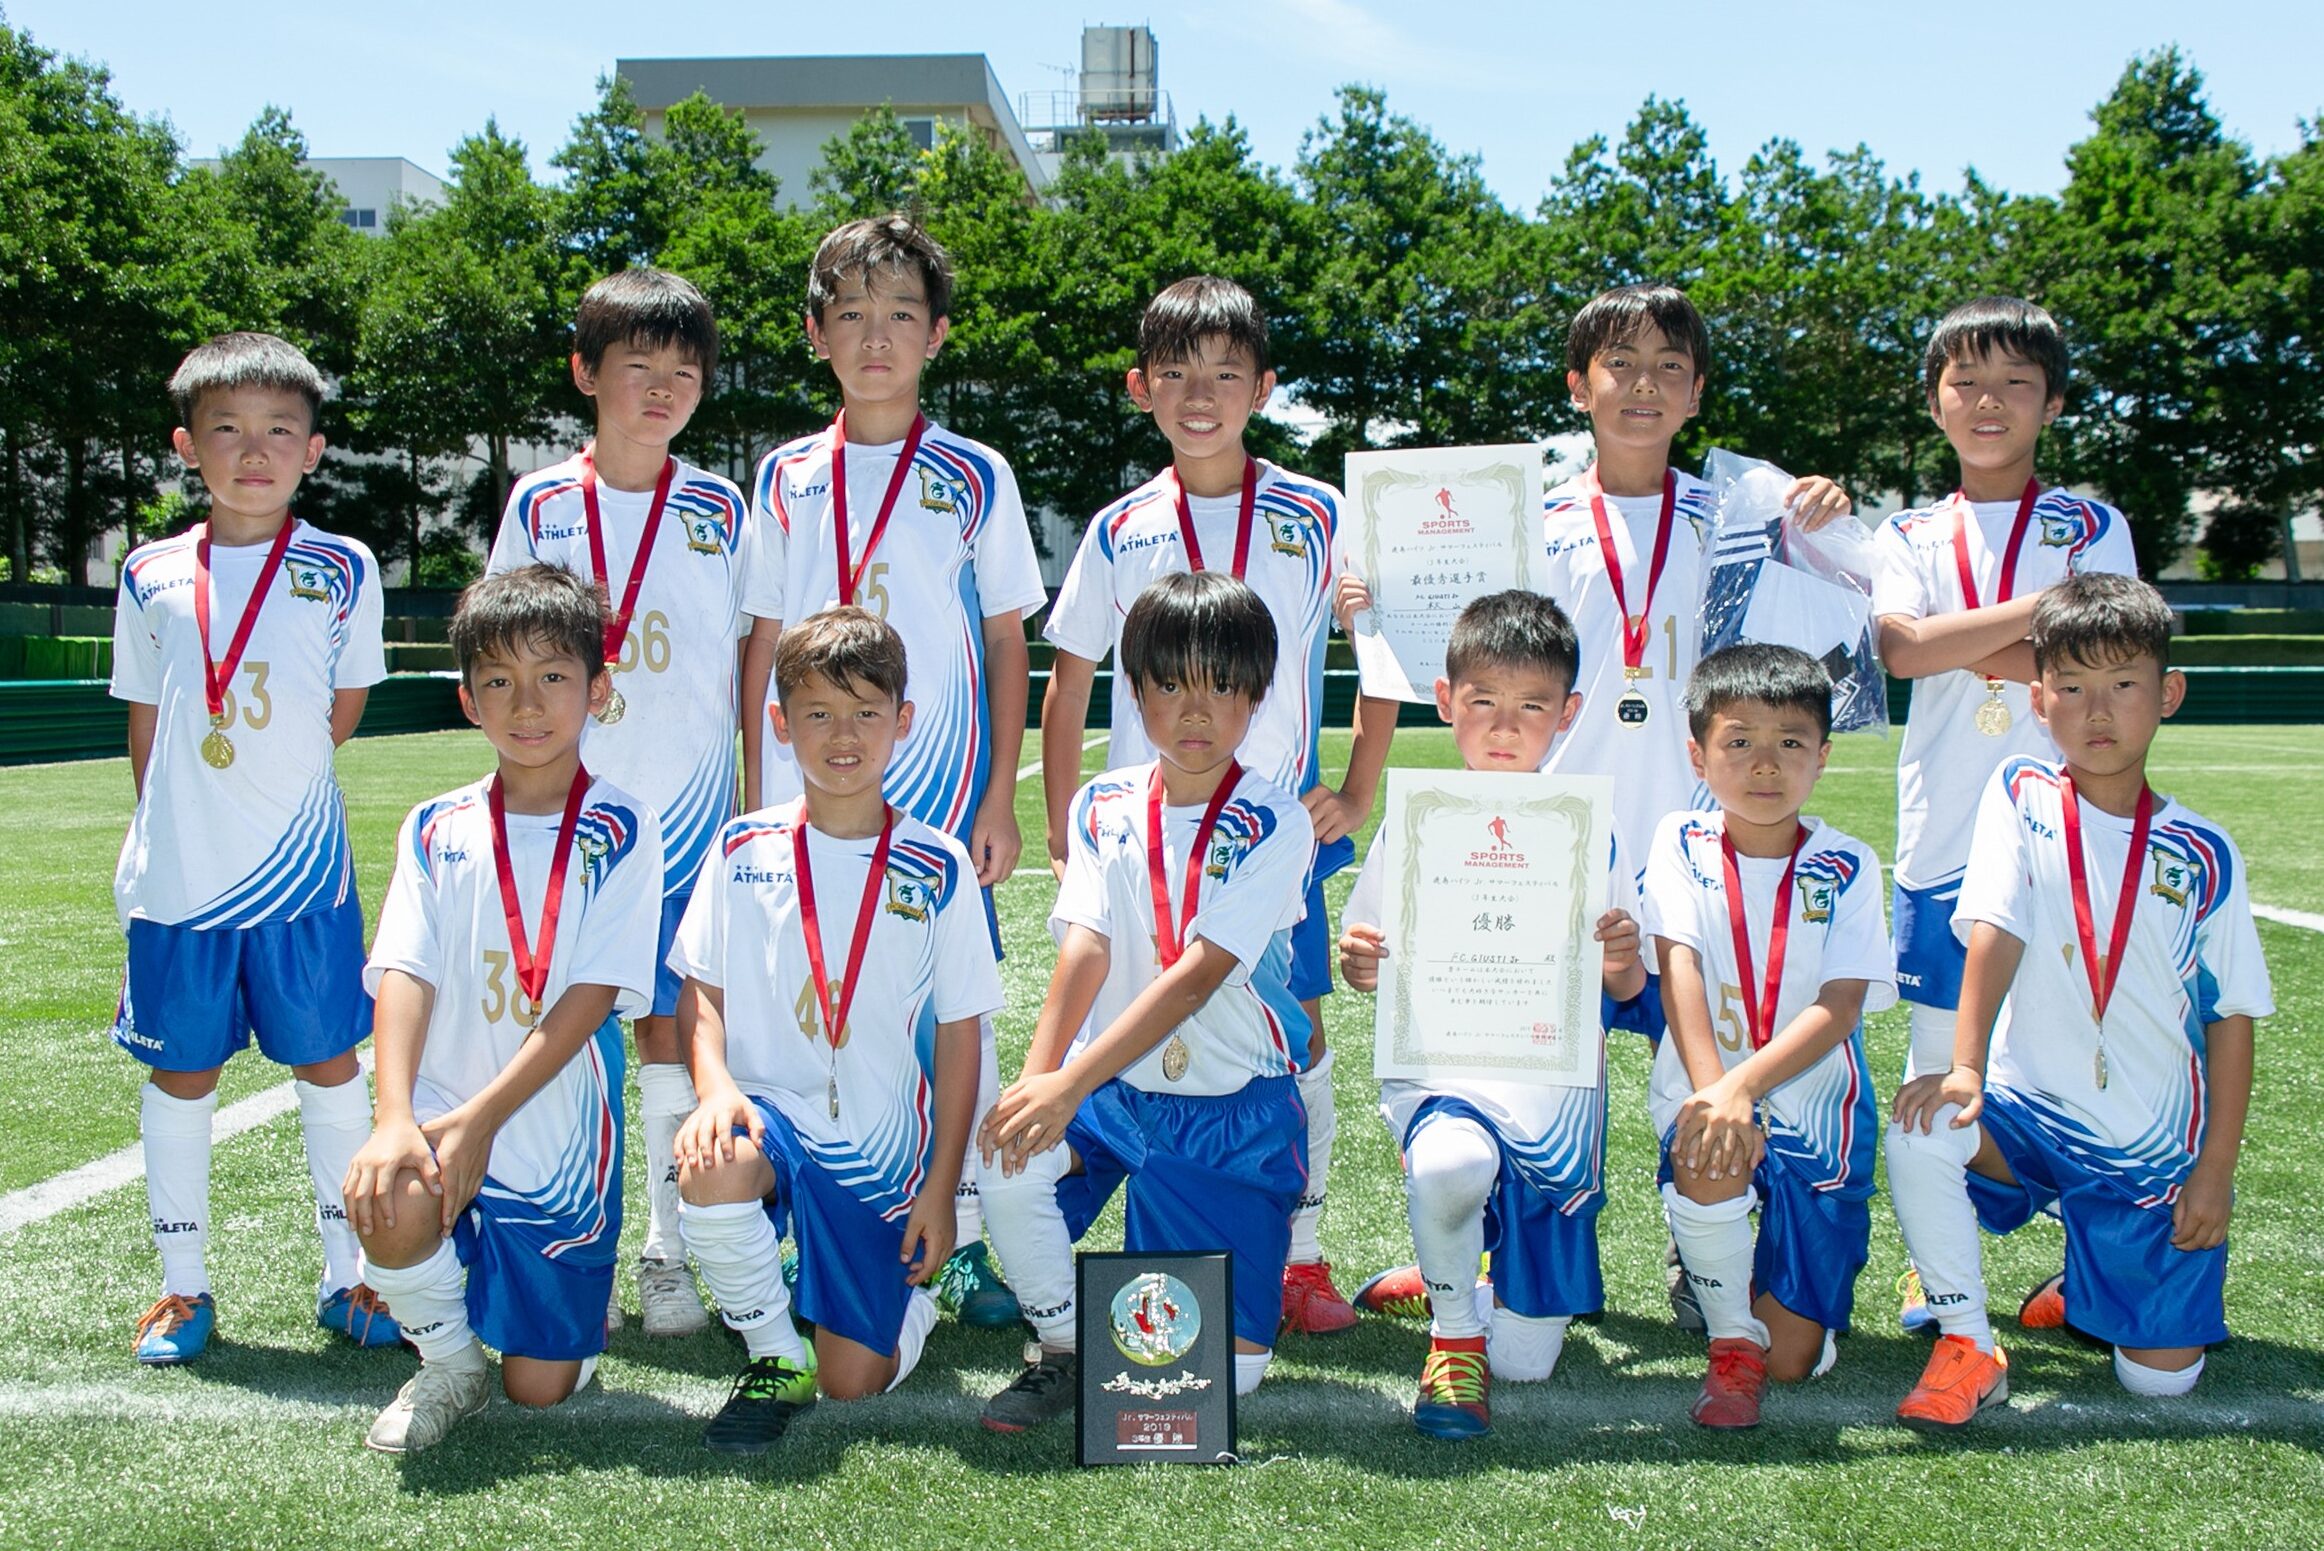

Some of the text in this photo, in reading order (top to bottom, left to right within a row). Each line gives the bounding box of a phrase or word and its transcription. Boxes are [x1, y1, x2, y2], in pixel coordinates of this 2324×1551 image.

[1422, 519, 1471, 529] SPORTS
[1417, 527, 1476, 536] MANAGEMENT
[1119, 532, 1178, 554] ATHLETA
[141, 577, 196, 603] ATHLETA
[1470, 851, 1525, 862] SPORTS
[1464, 860, 1530, 869] MANAGEMENT
[733, 871, 794, 884] ATHLETA
[1472, 912, 1516, 933] 優勝
[153, 1221, 198, 1234] THLETA
[1143, 1422, 1172, 1432] 2019
